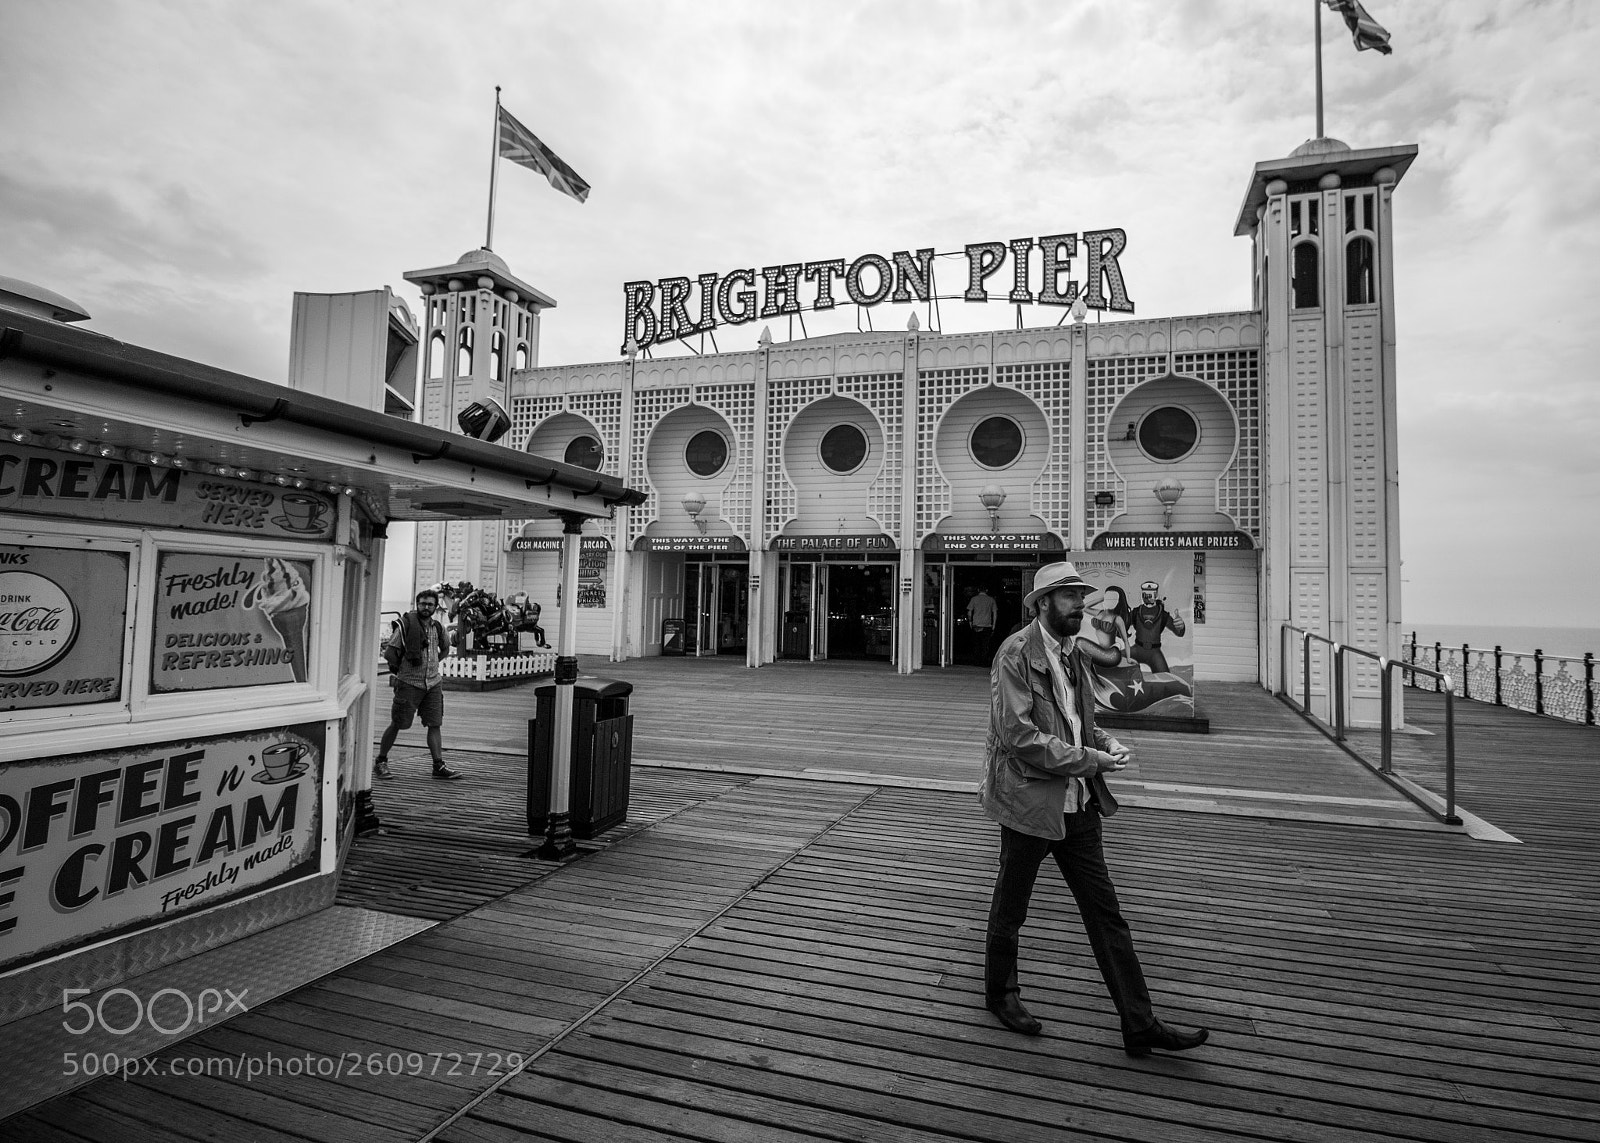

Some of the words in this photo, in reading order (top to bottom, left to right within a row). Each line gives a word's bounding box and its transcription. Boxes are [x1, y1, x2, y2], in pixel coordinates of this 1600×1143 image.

[620, 247, 935, 355] BRIGHTON
[965, 228, 1134, 313] PIER
[0, 454, 182, 503] CREAM
[197, 481, 274, 507] SERVED
[202, 504, 269, 529] HERE
[516, 541, 532, 549] CASH
[533, 541, 559, 549] MACHINE
[584, 541, 608, 549] ARCADE
[776, 538, 796, 549] THE
[801, 538, 841, 549] PALACE
[846, 538, 860, 548] OF
[866, 538, 888, 548] FUN
[1106, 538, 1136, 548] WHERE
[1140, 537, 1174, 547] TICKETS
[1178, 537, 1204, 547] MAKE
[1207, 536, 1239, 546] PRIZES
[165, 562, 255, 597] Freshly
[170, 590, 238, 620] made!
[164, 632, 252, 649] DELICIOUS
[253, 633, 262, 644] &
[161, 648, 294, 672] REFRESHING
[62, 677, 116, 695] HERE
[53, 784, 299, 911] CREAM
[161, 862, 239, 912] Freshly
[244, 835, 294, 871] made
